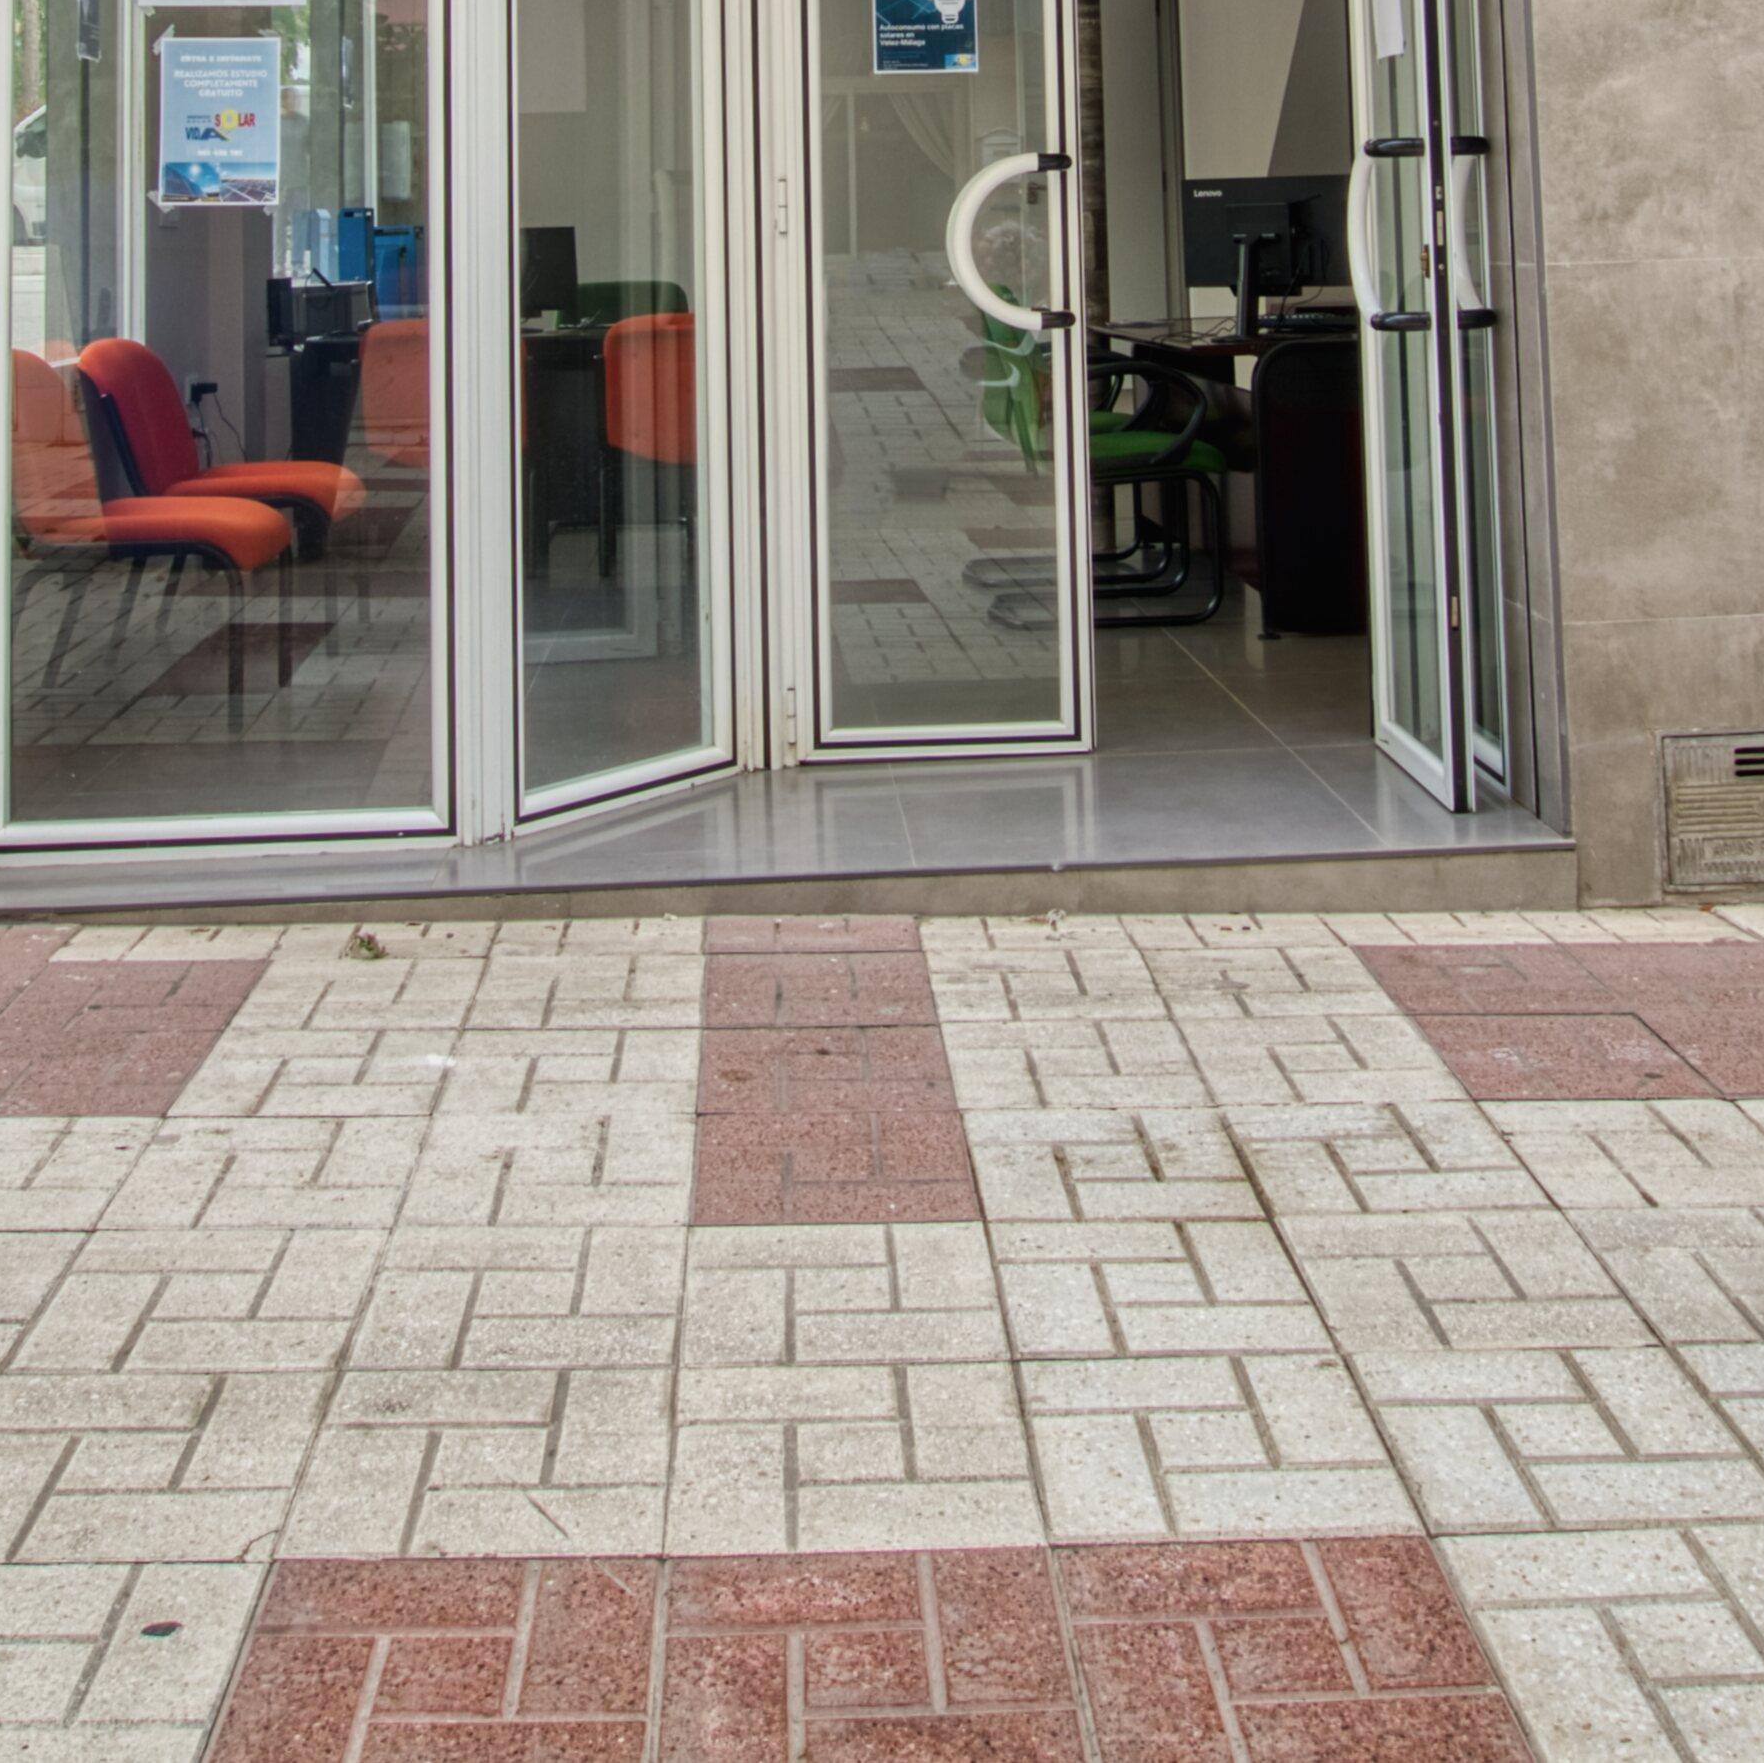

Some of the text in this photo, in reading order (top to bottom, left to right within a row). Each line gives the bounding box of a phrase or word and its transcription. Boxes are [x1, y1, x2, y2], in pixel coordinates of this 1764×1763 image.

[174, 70, 268, 78] REALIZAMOS ESTUDIO
[198, 89, 244, 97] GRATUITO
[215, 109, 256, 130] SOLAR
[1193, 189, 1223, 198] Lenovo
